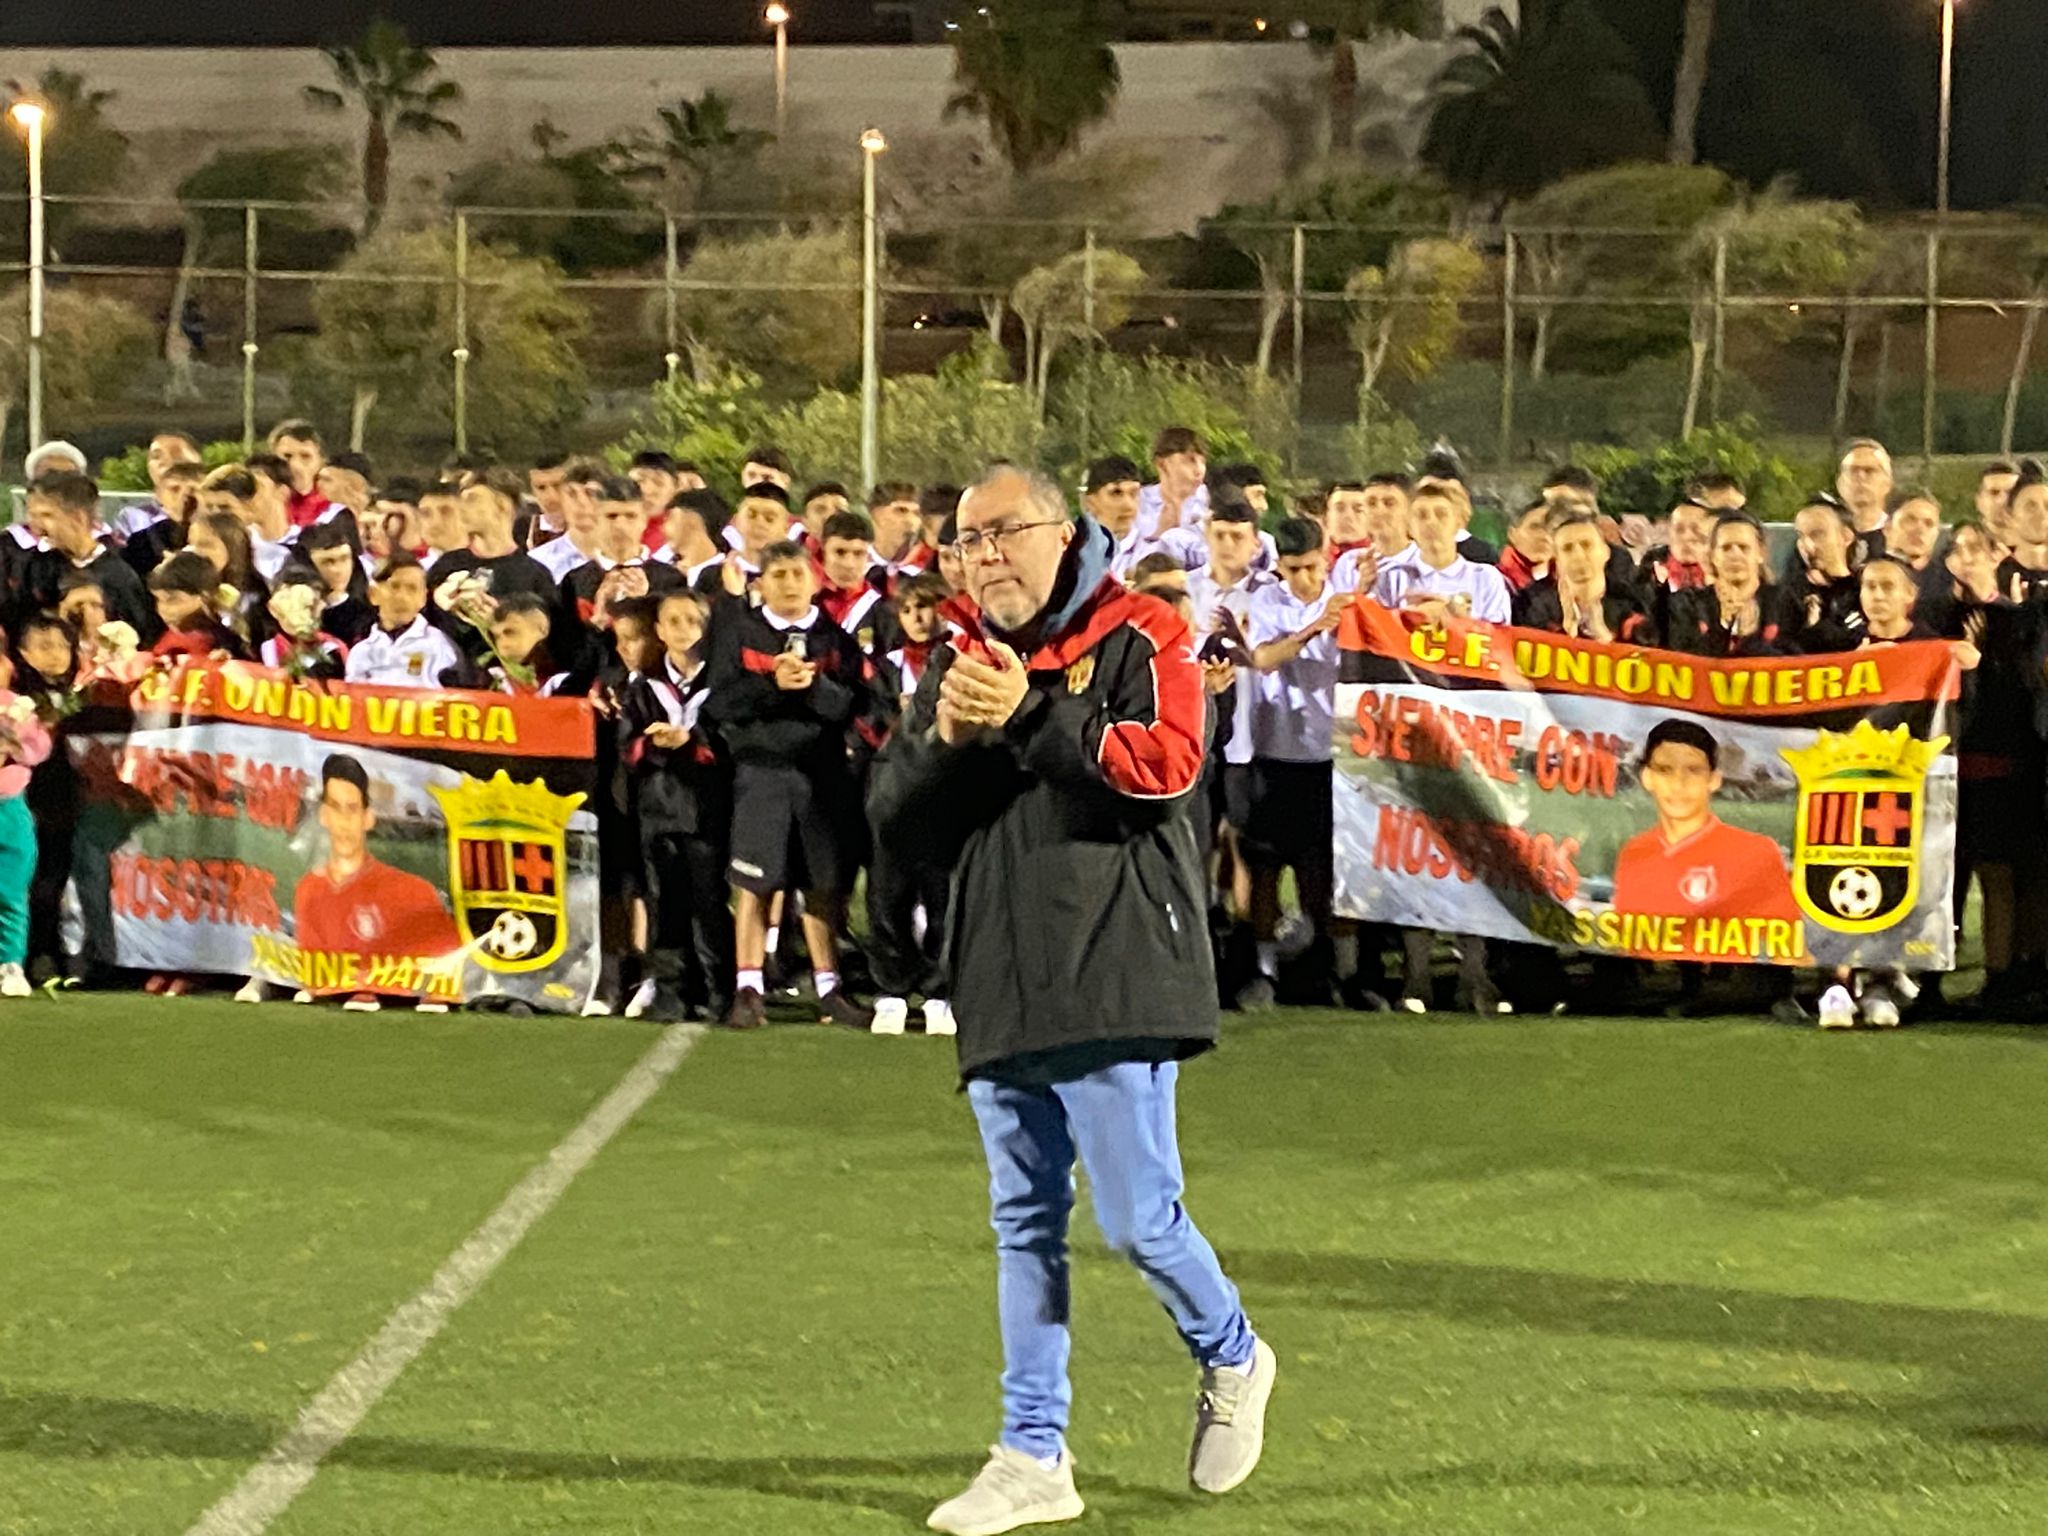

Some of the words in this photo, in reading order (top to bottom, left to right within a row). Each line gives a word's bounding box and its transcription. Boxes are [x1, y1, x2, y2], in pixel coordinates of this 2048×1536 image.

[1410, 624, 1501, 671] C.F.
[1515, 640, 1694, 700] UNIÓN
[1709, 660, 1883, 706] VIERA
[366, 696, 518, 744] VIERA
[1536, 725, 1622, 797] CON
[1694, 918, 1805, 958] HATRI
